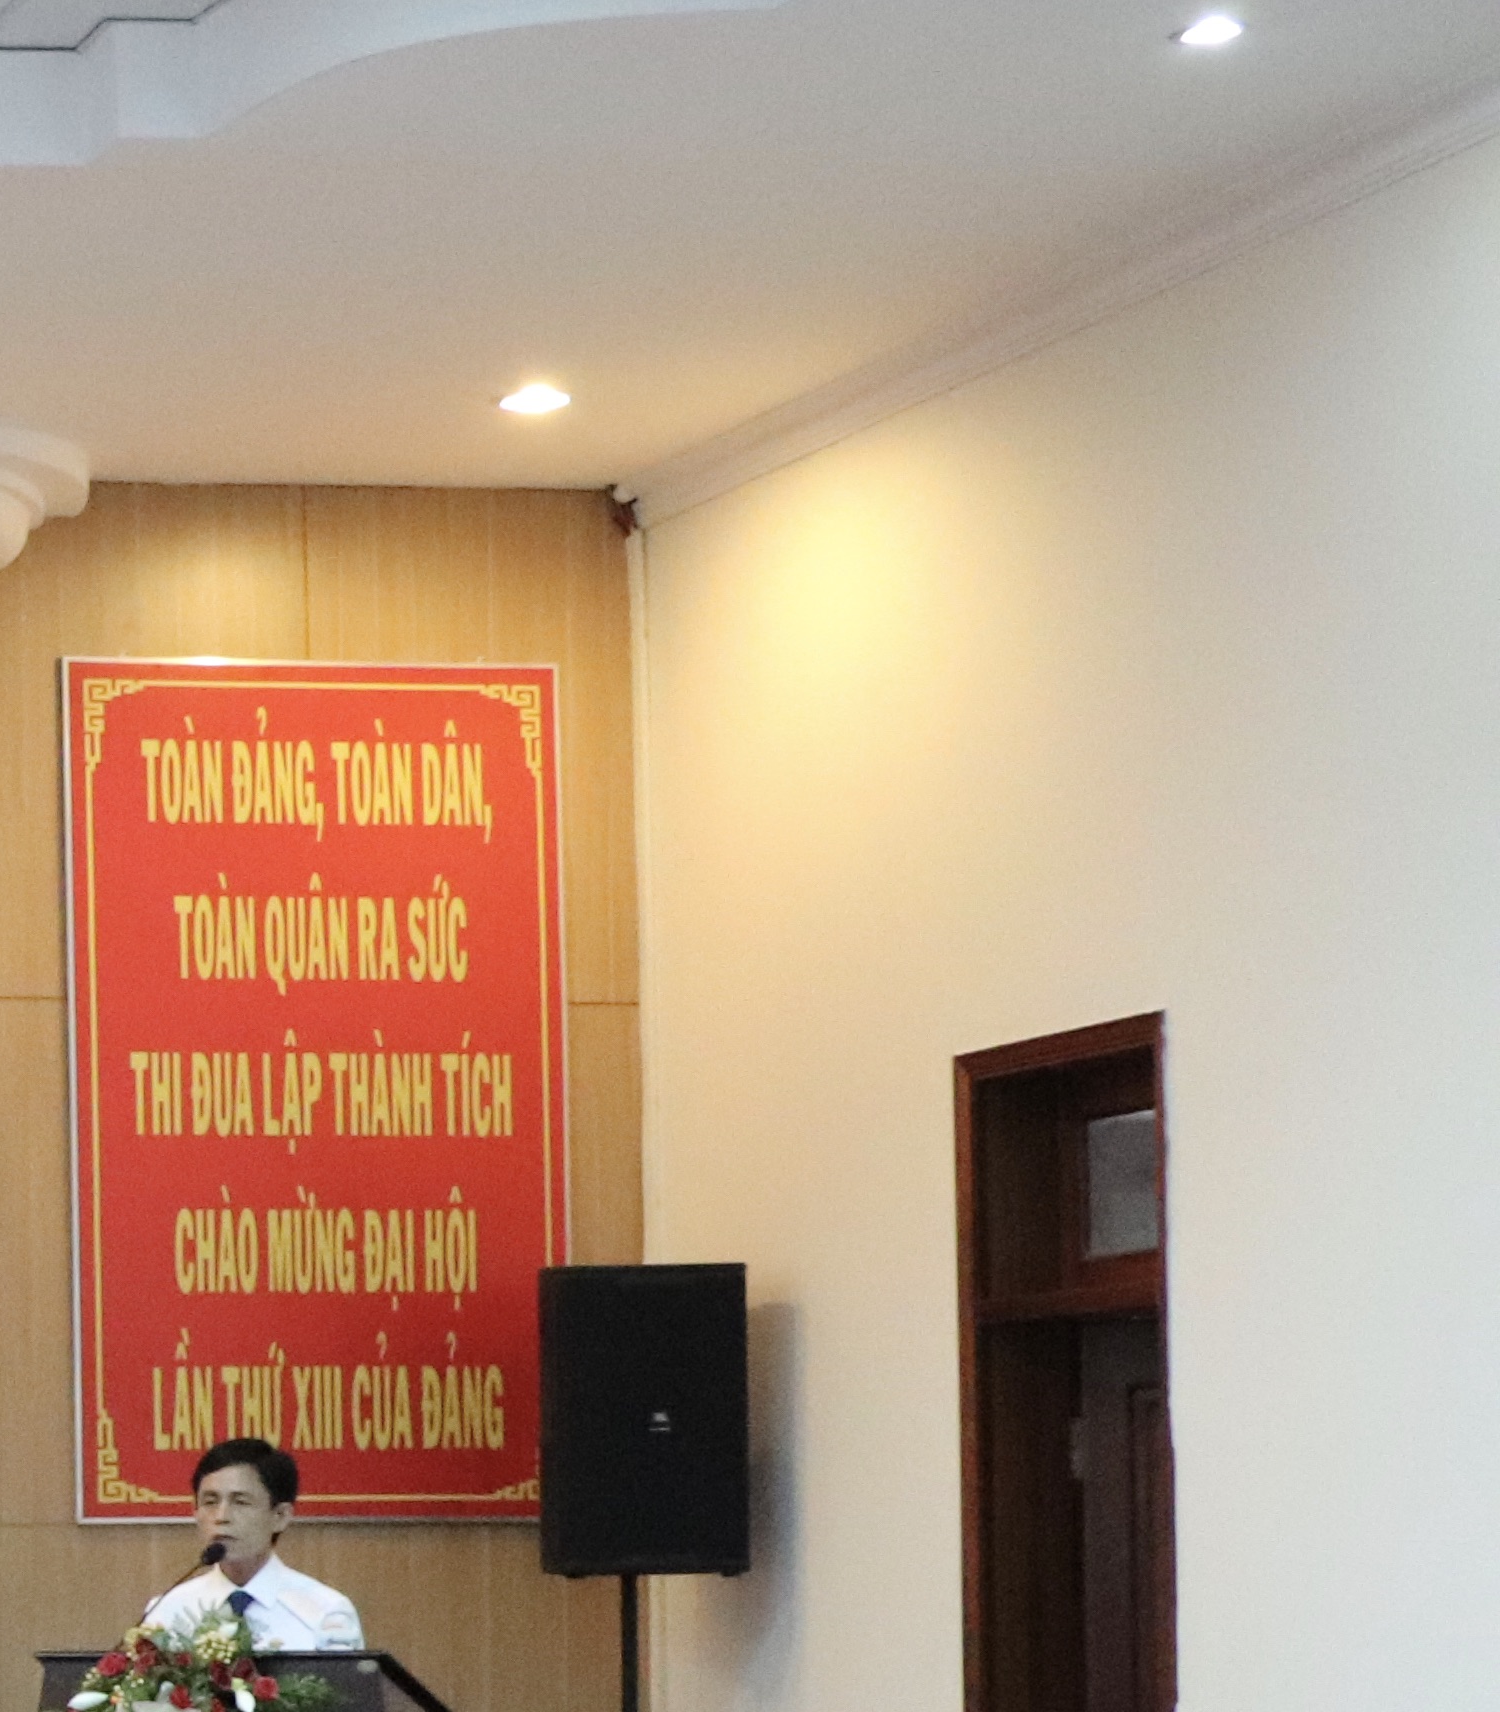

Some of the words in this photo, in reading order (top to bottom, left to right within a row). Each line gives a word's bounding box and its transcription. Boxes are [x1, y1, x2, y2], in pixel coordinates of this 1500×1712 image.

[140, 714, 226, 825] TOÀN
[230, 705, 327, 842] ĐẢNG,
[328, 717, 419, 827] TOÀN
[416, 718, 495, 844] DÂN,
[173, 872, 257, 980] TOÀN
[264, 872, 350, 996] QUÂN
[357, 896, 401, 981] RA
[407, 874, 468, 982] SỨC
[130, 1051, 182, 1136] THI
[191, 1052, 254, 1137] ĐUA
[262, 1029, 322, 1153] LẬP
[329, 1029, 432, 1136] THÀNH
[440, 1031, 512, 1137] TÍCH
[175, 1185, 258, 1294] CHÀO
[267, 1186, 355, 1293] MỪNG
[364, 1210, 414, 1311] ĐẠI
[425, 1186, 477, 1311] HỘI
[153, 1329, 213, 1450] LẦN
[222, 1342, 284, 1448] THỨ
[293, 1366, 342, 1449] XIII
[352, 1333, 412, 1449] CỦA
[422, 1333, 502, 1447] ĐẢNG
